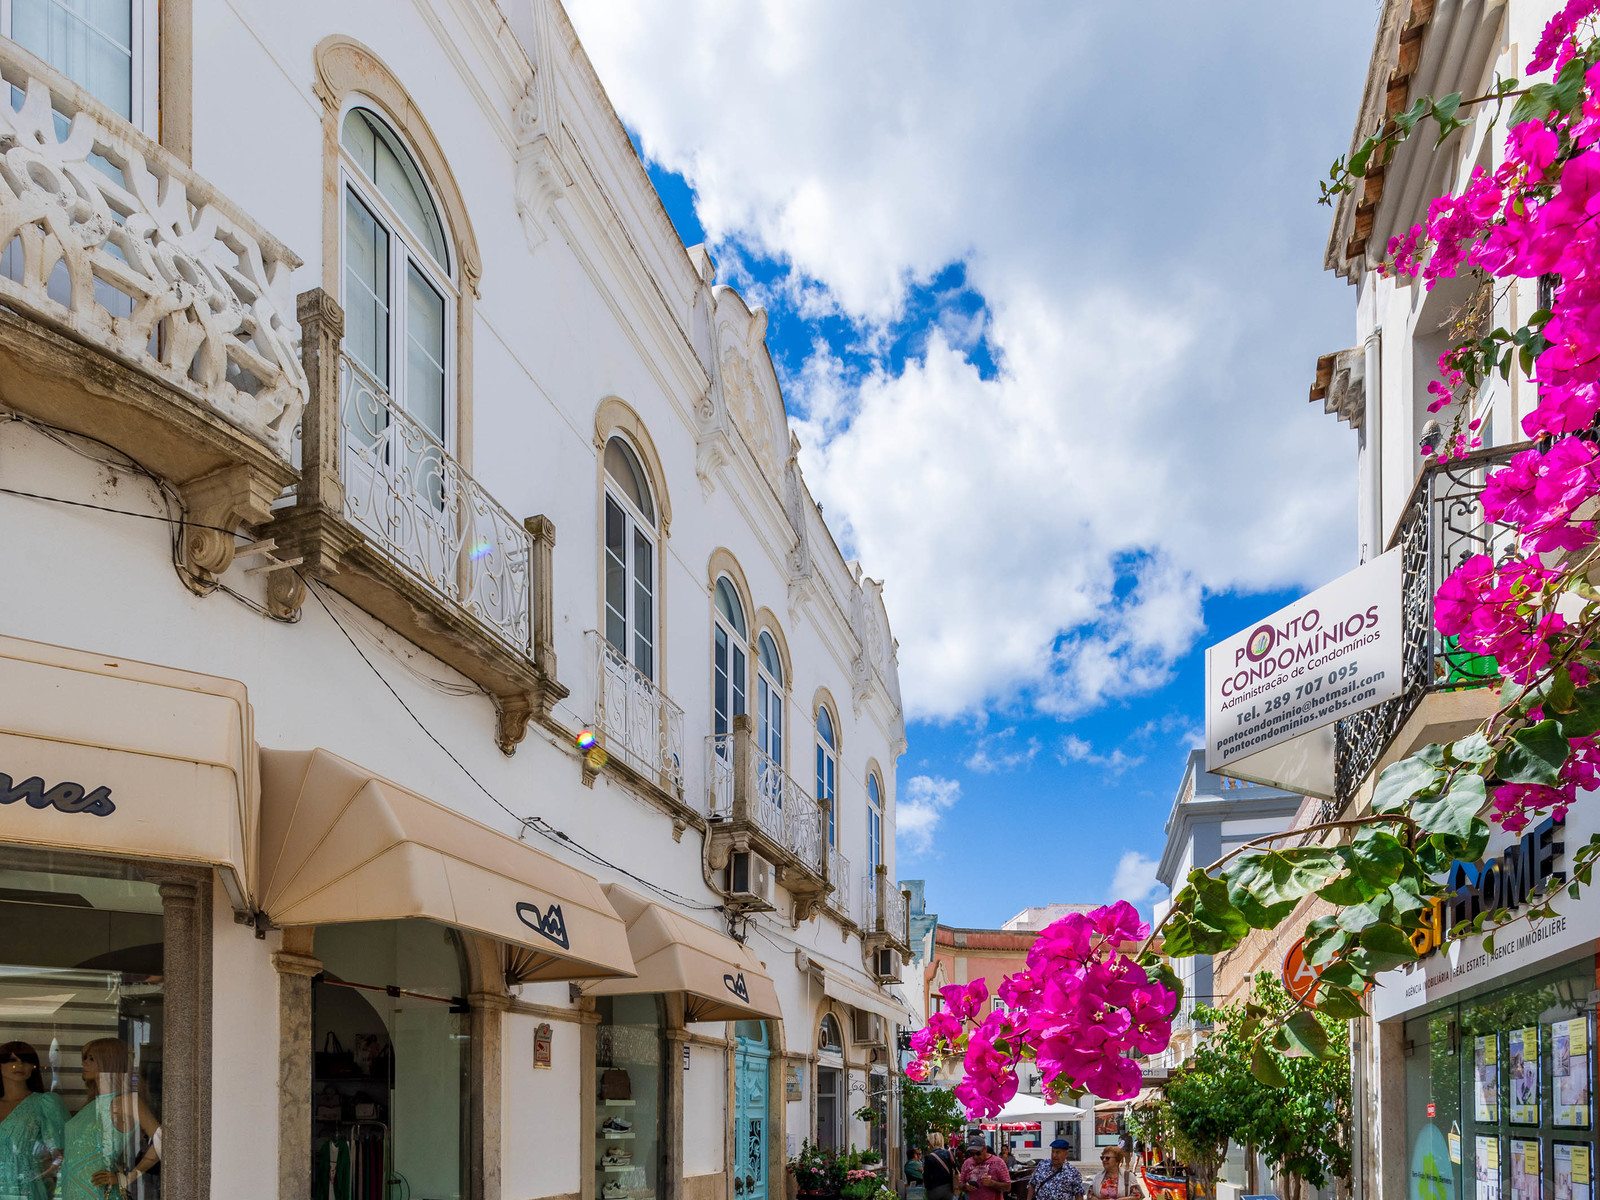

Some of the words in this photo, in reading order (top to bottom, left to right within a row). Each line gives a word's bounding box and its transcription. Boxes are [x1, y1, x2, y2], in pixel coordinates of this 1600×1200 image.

[1220, 674, 1289, 712] Administração
[1291, 666, 1305, 679] de
[1307, 630, 1381, 671] Condomínios
[1221, 605, 1379, 697] CONDOMÍNIOS
[1235, 609, 1320, 668] PONTO
[1217, 670, 1385, 751] pontocondominio@hotmail.com
[1223, 687, 1376, 759] pontocondominios.webs.com
[1236, 705, 1261, 726] Tel.
[1264, 691, 1291, 714] 289
[1295, 676, 1323, 701] 707
[1328, 661, 1359, 685] 095
[1466, 953, 1486, 973] ESTATE
[1490, 941, 1515, 963] AGENCE
[1516, 916, 1567, 951] IMMOBILIÈRE
